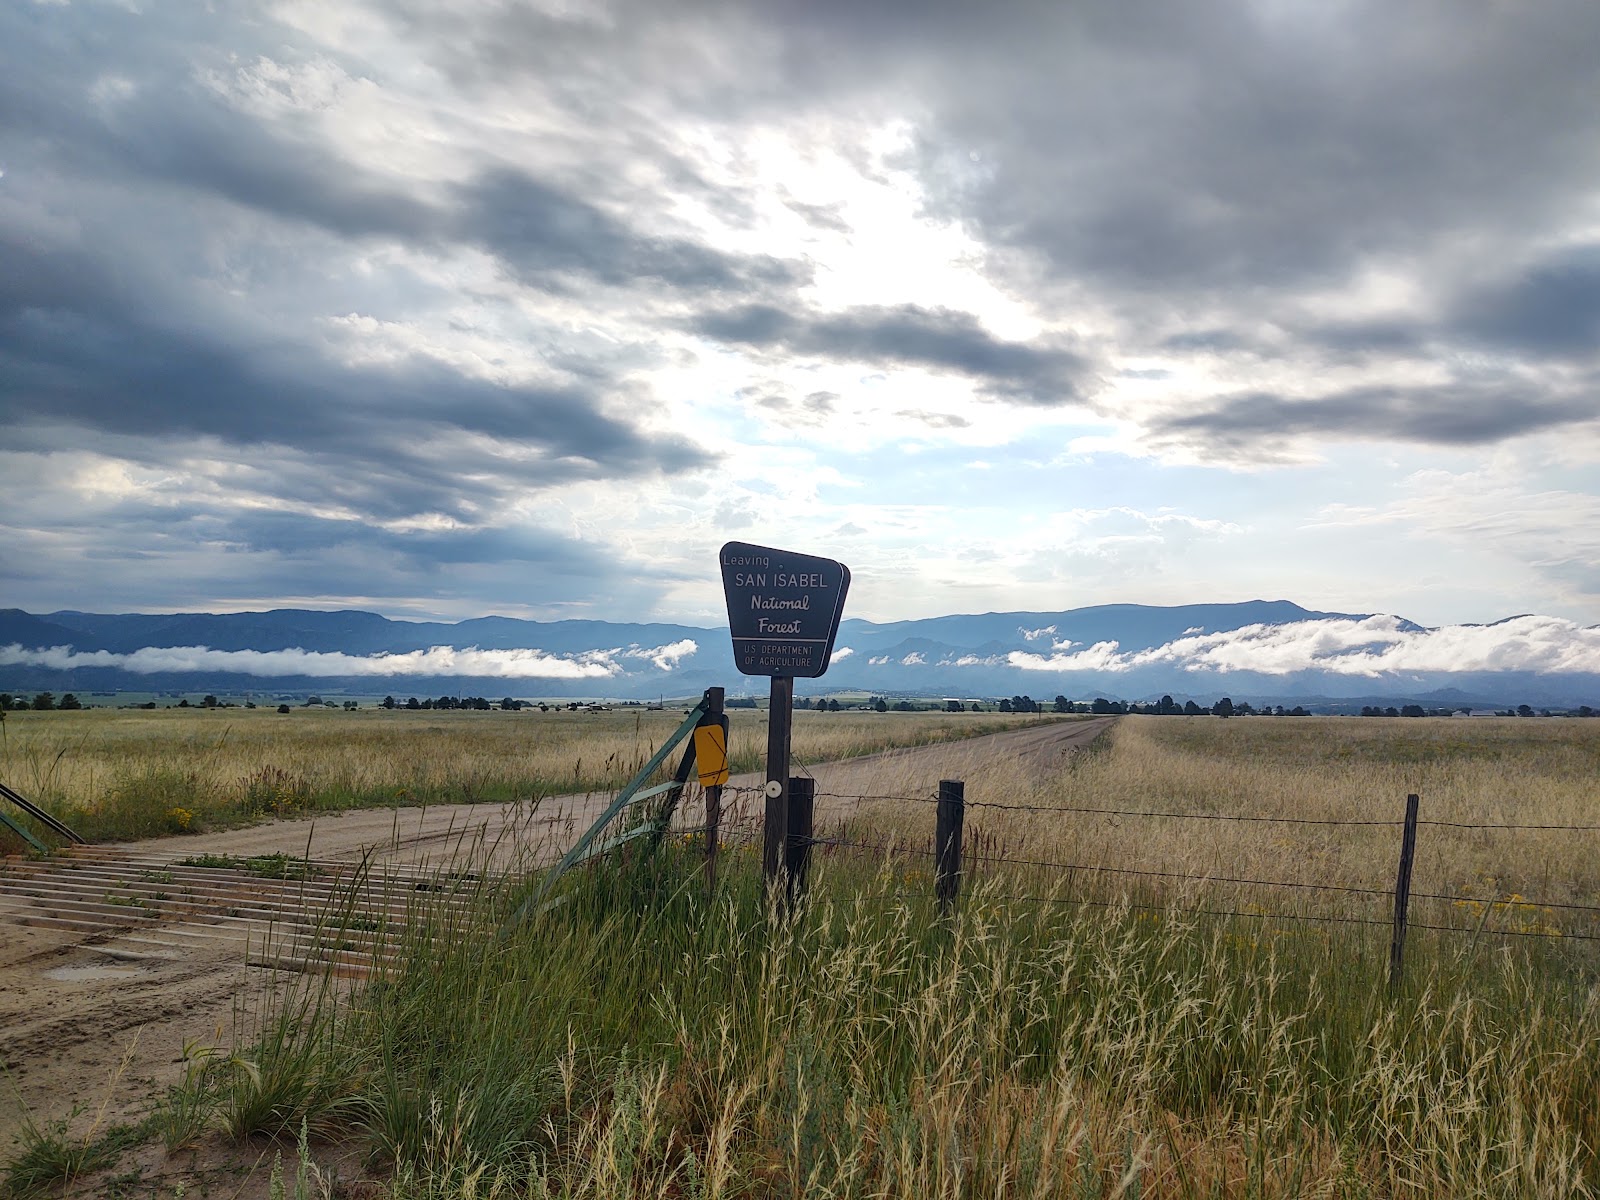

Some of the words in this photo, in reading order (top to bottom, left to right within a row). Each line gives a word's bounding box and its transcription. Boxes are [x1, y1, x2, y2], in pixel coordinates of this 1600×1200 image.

[723, 554, 769, 569] Leaving
[735, 573, 766, 587] SAN
[773, 573, 828, 588] ISABEL
[751, 595, 810, 610] National
[758, 617, 802, 634] Forest
[761, 645, 813, 655] DEPARTMENT
[744, 656, 754, 665] OF
[759, 656, 811, 667] AGRICULTURE
